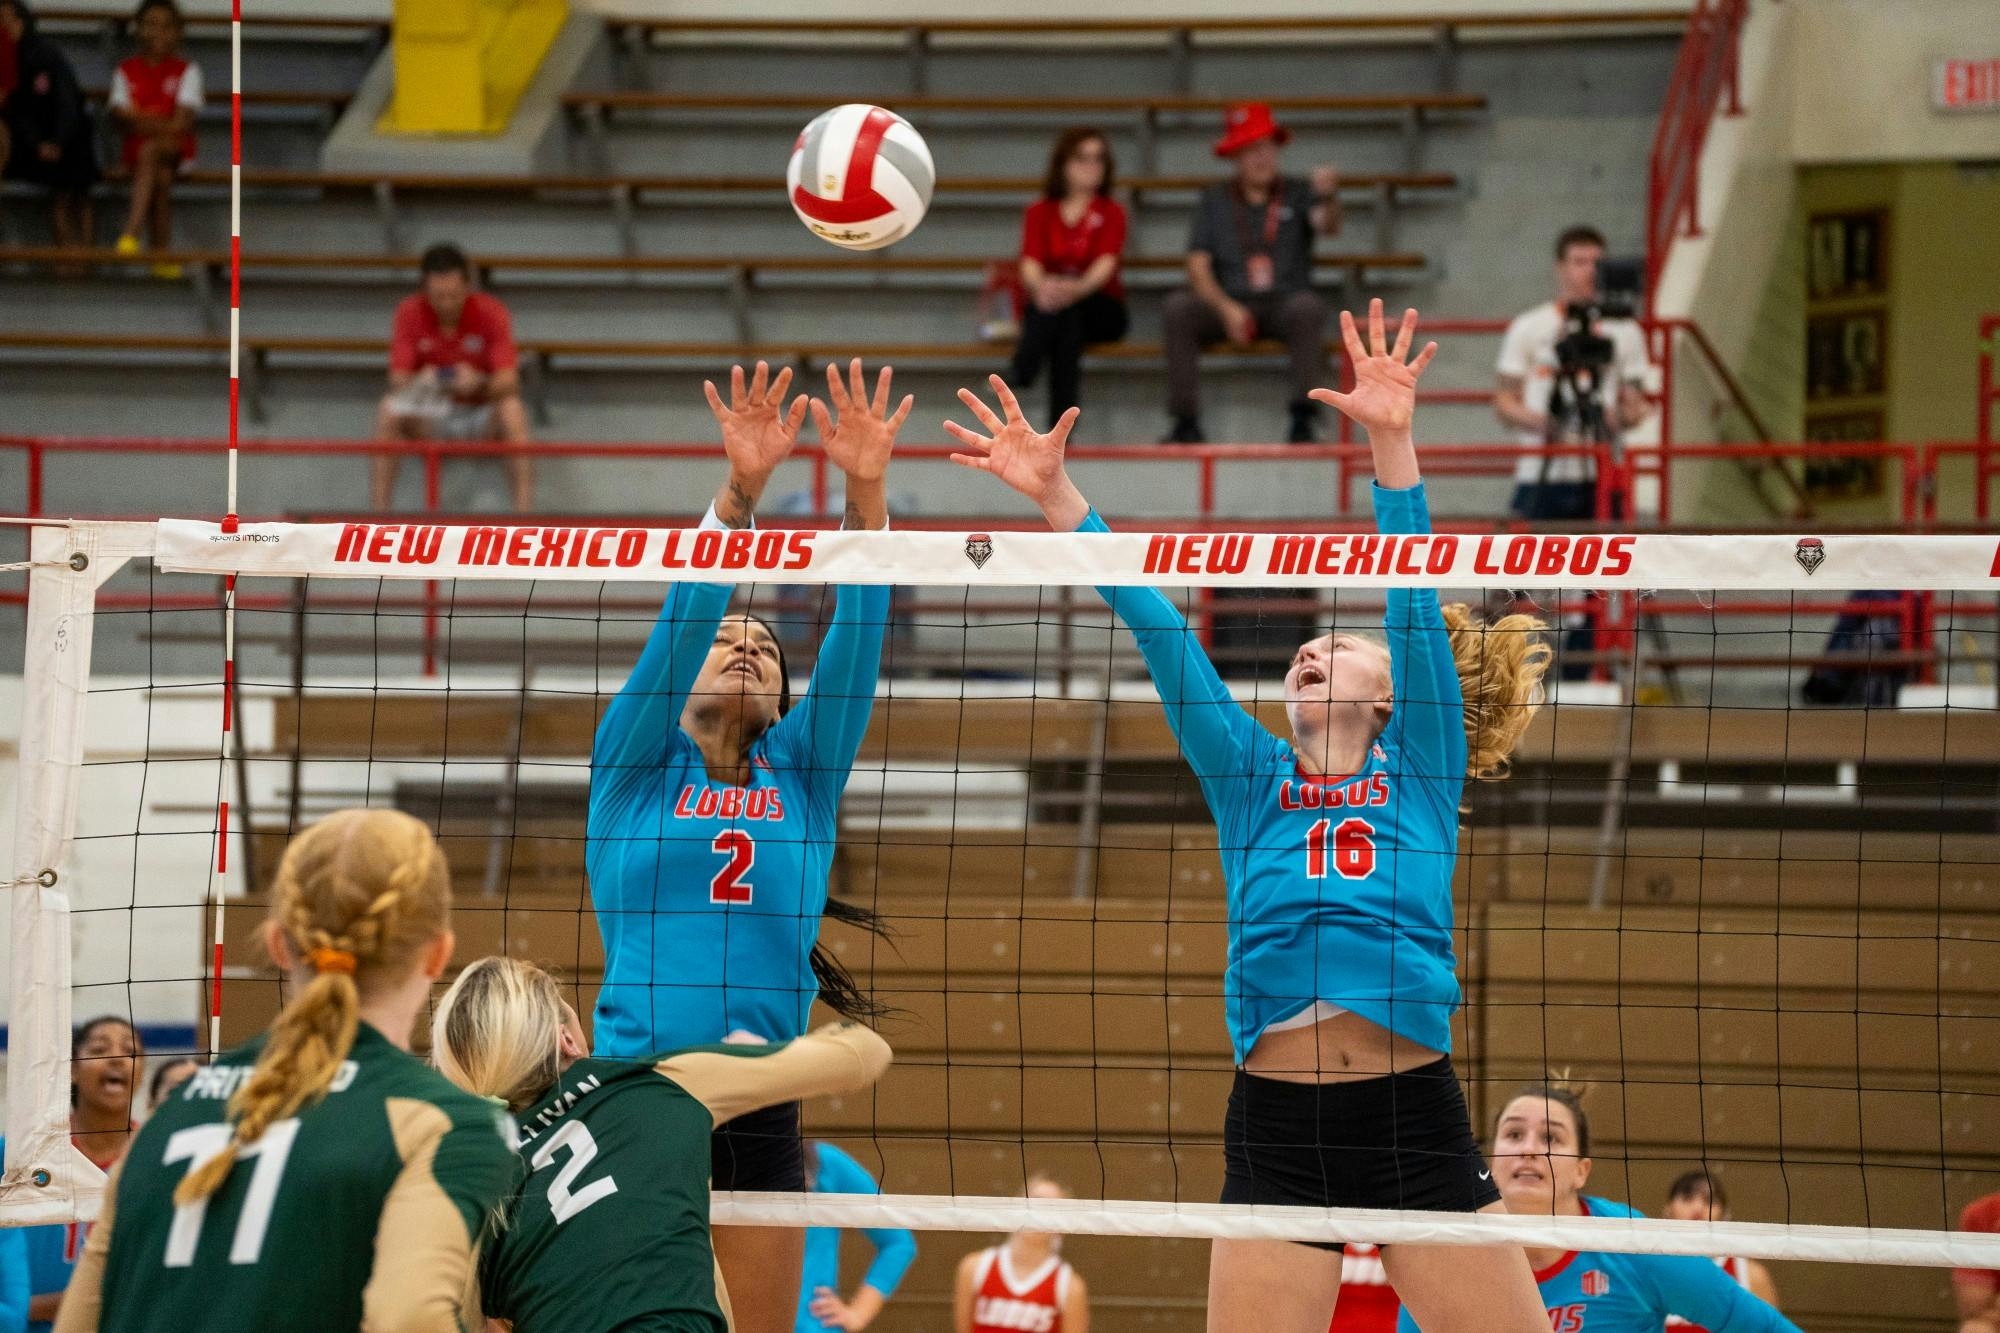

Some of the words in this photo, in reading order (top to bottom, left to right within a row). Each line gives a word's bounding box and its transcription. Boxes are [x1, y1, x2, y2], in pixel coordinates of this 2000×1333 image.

[242, 532, 280, 543] imports
[334, 523, 446, 564] NEW
[457, 526, 649, 569] MEXICO
[661, 529, 817, 570] LOBOS
[1142, 534, 1254, 574] NEW
[1266, 535, 1459, 576] MEXICO
[1474, 535, 1637, 576] LOBOS
[674, 784, 784, 822] LOBOS
[1280, 771, 1389, 811] LOBOS
[710, 828, 756, 905] 2
[1304, 817, 1376, 880] 16
[162, 1117, 301, 1268] 11
[531, 1119, 618, 1225] 2
